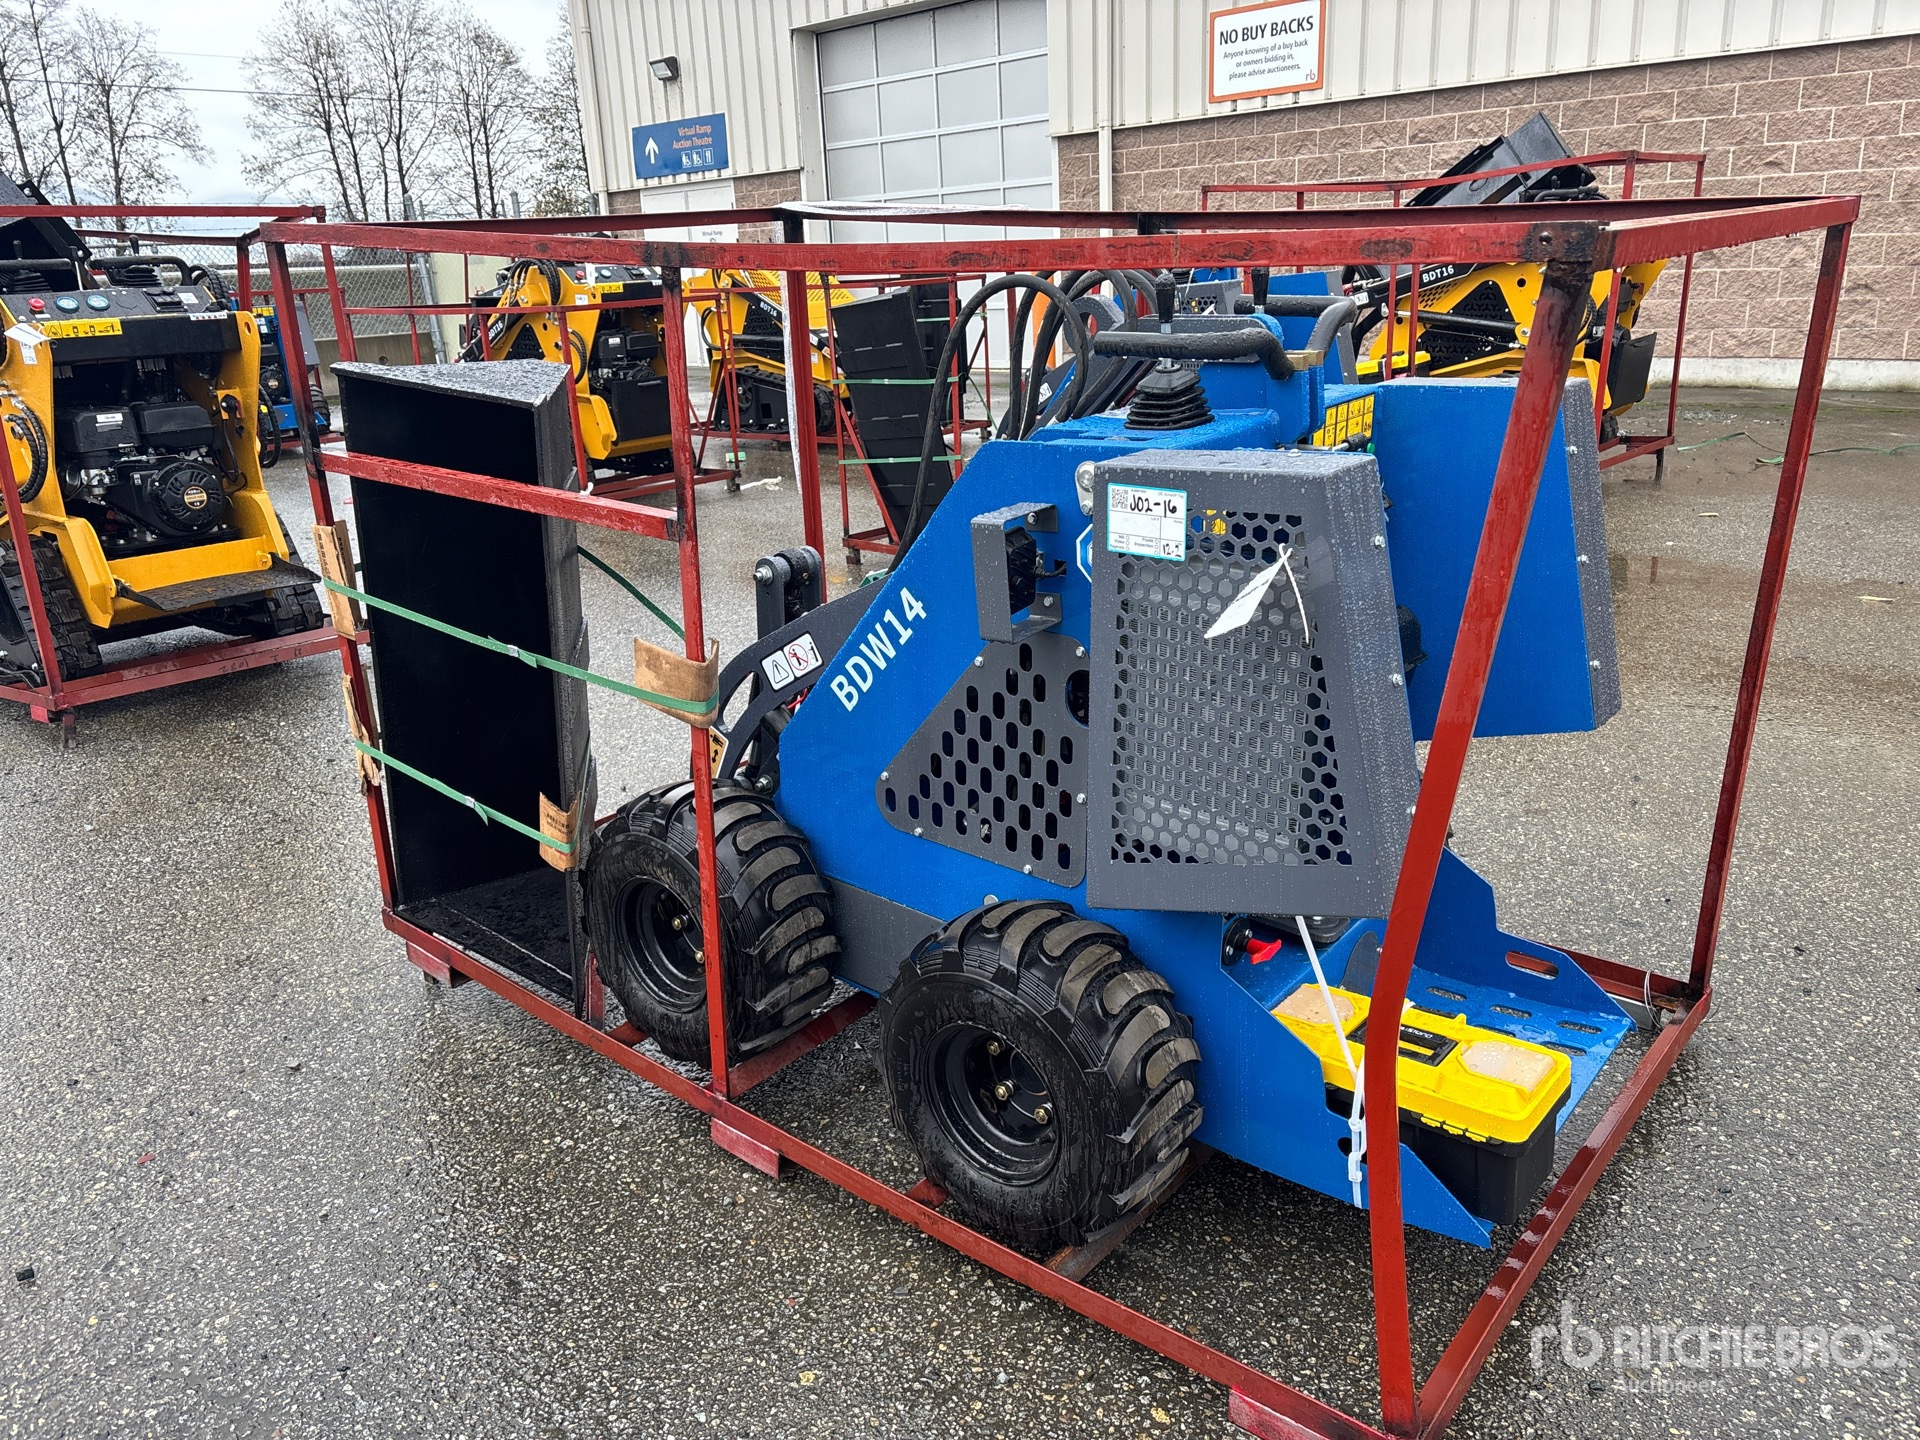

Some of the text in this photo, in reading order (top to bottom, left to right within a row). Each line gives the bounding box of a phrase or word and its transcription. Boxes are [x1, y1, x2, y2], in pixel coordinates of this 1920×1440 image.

[1219, 15, 1314, 45] NO BUY BACKS
[1223, 48, 1244, 60] Anyone
[1245, 45, 1269, 56] knowing
[1270, 43, 1277, 52] of
[1282, 41, 1293, 51] buy
[1294, 38, 1308, 48] back
[1243, 58, 1263, 67] owners
[1264, 53, 1286, 64] bidding
[1229, 63, 1301, 81] please advise auctioneers.
[1305, 69, 1316, 81] rb
[677, 125, 712, 136] Virtual Ramp
[672, 136, 713, 149] Auction Theatre
[1422, 265, 1455, 283] BDT16
[1130, 494, 1177, 518] J02-16
[829, 587, 927, 712] BDW14
